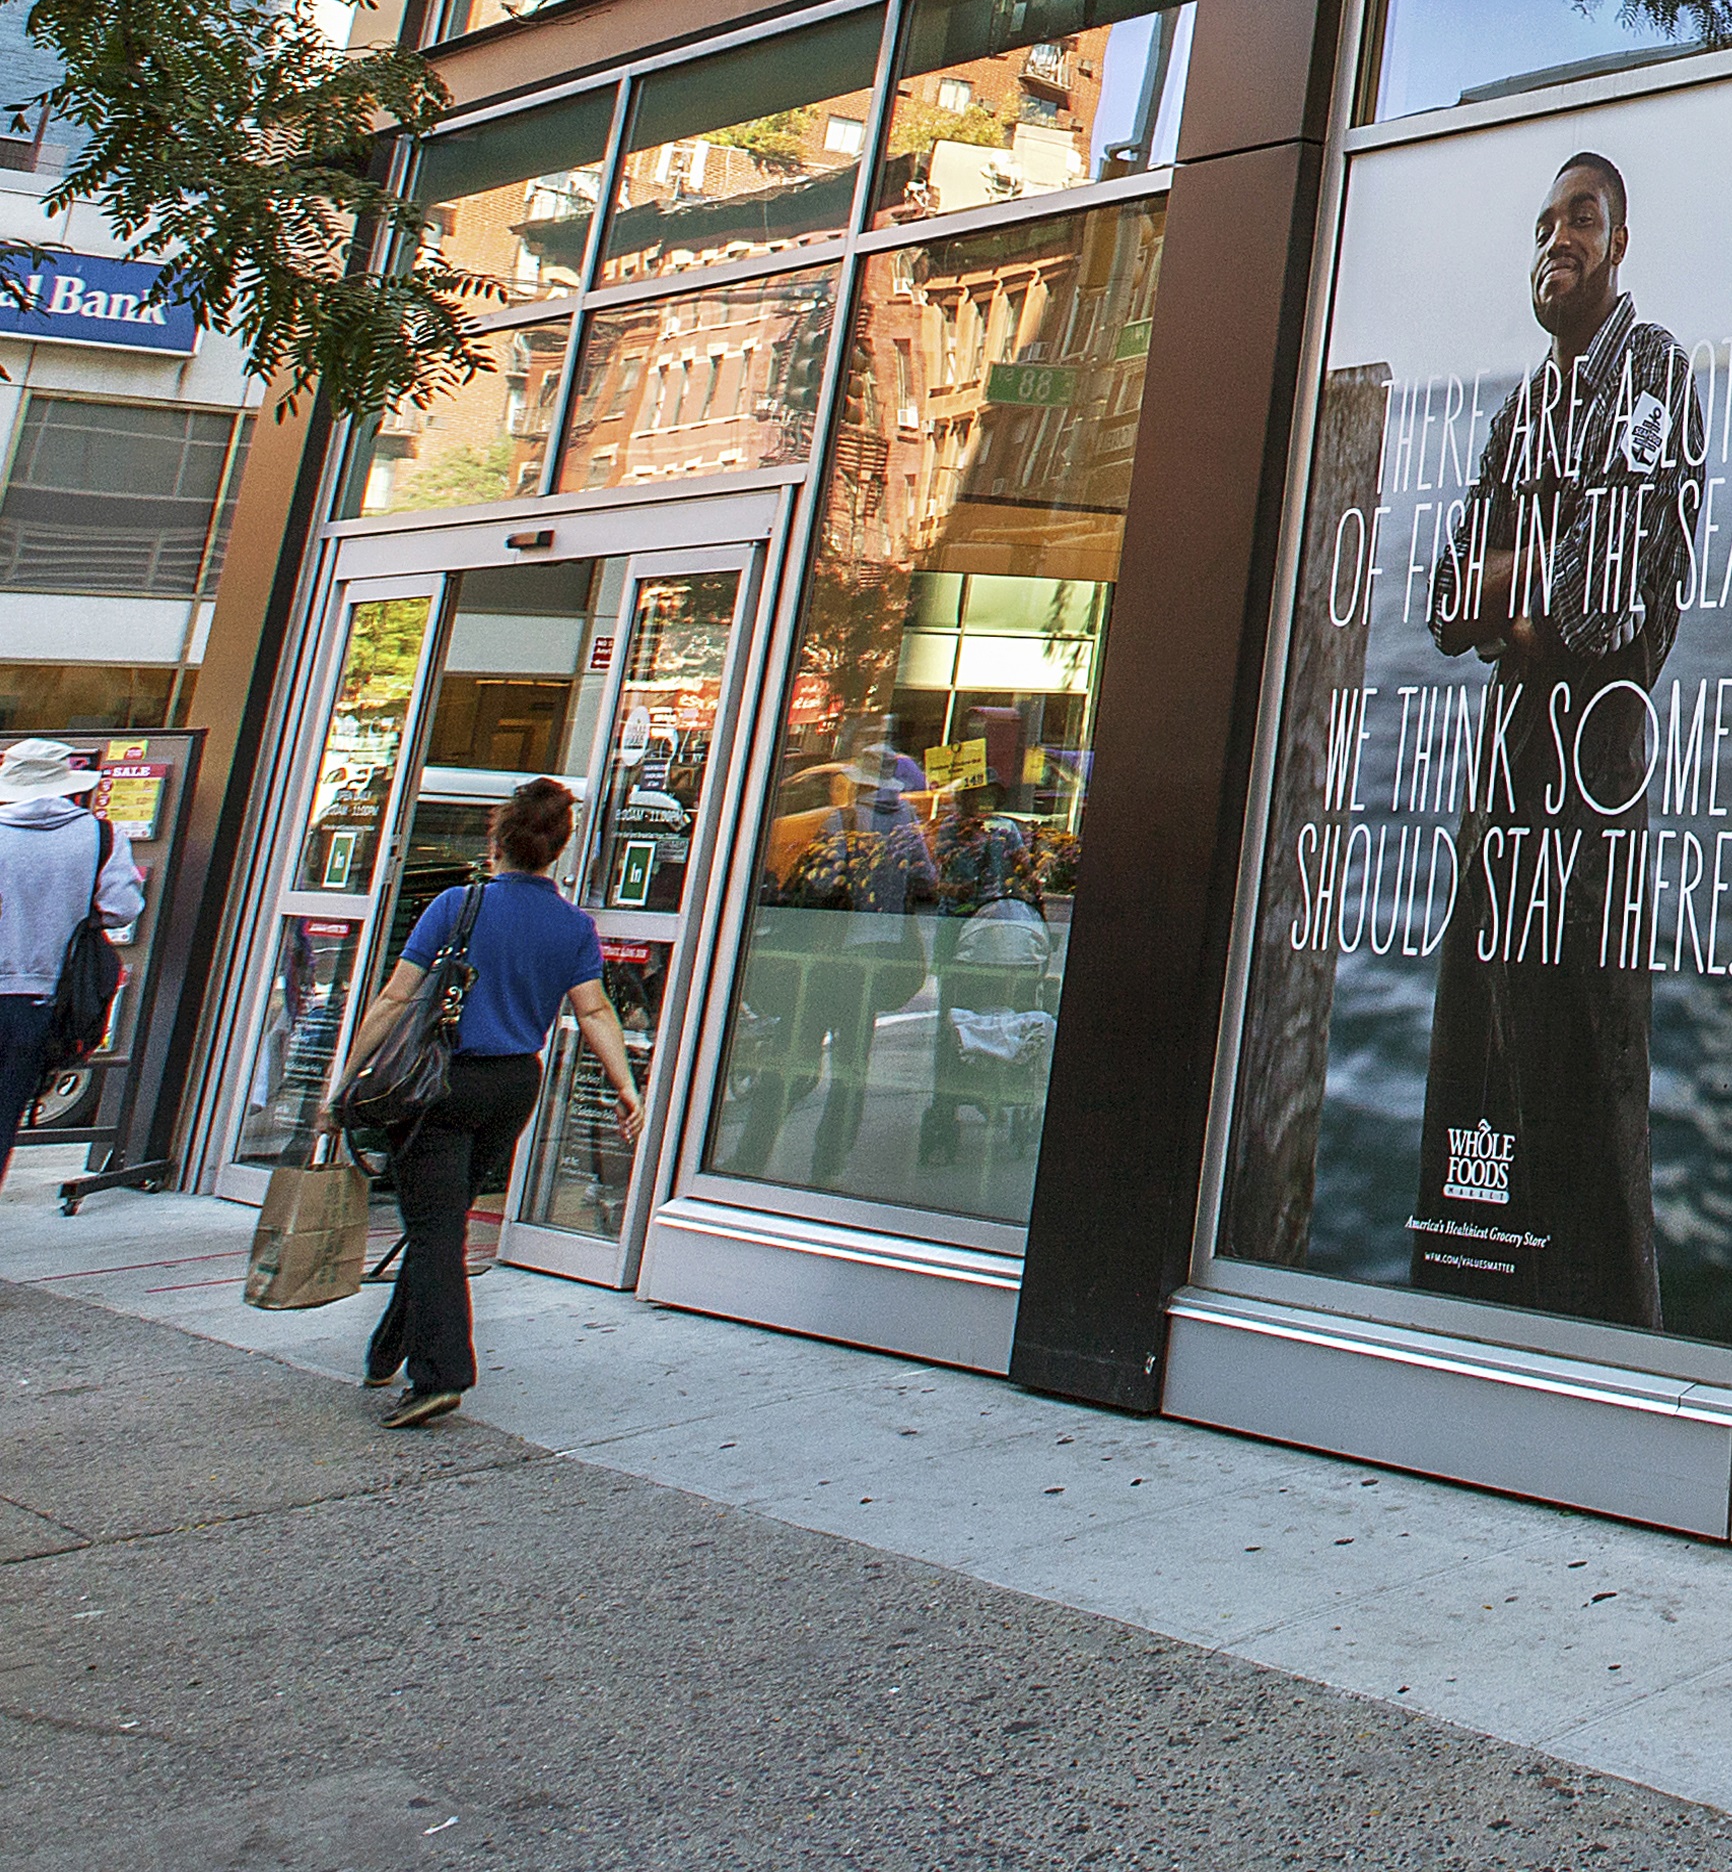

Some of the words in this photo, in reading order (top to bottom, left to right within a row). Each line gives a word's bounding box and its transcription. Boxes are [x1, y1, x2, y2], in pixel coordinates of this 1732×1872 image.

[1375, 369, 1491, 495] THERE
[1502, 354, 1589, 483] ARE
[1602, 348, 1635, 475] A
[1328, 506, 1391, 627] OF
[1403, 497, 1491, 623] FISH
[1508, 490, 1561, 619] IN
[1582, 482, 1655, 615] THE
[112, 766, 151, 777] SALE
[1324, 686, 1378, 812] WE
[1392, 682, 1524, 814] THINK
[630, 864, 642, 885] In
[1291, 822, 1459, 957] SHOULD
[1477, 826, 1583, 965] STAY
[1446, 1156, 1510, 1190] FOODS
[1447, 1118, 1516, 1162] WHOLE
